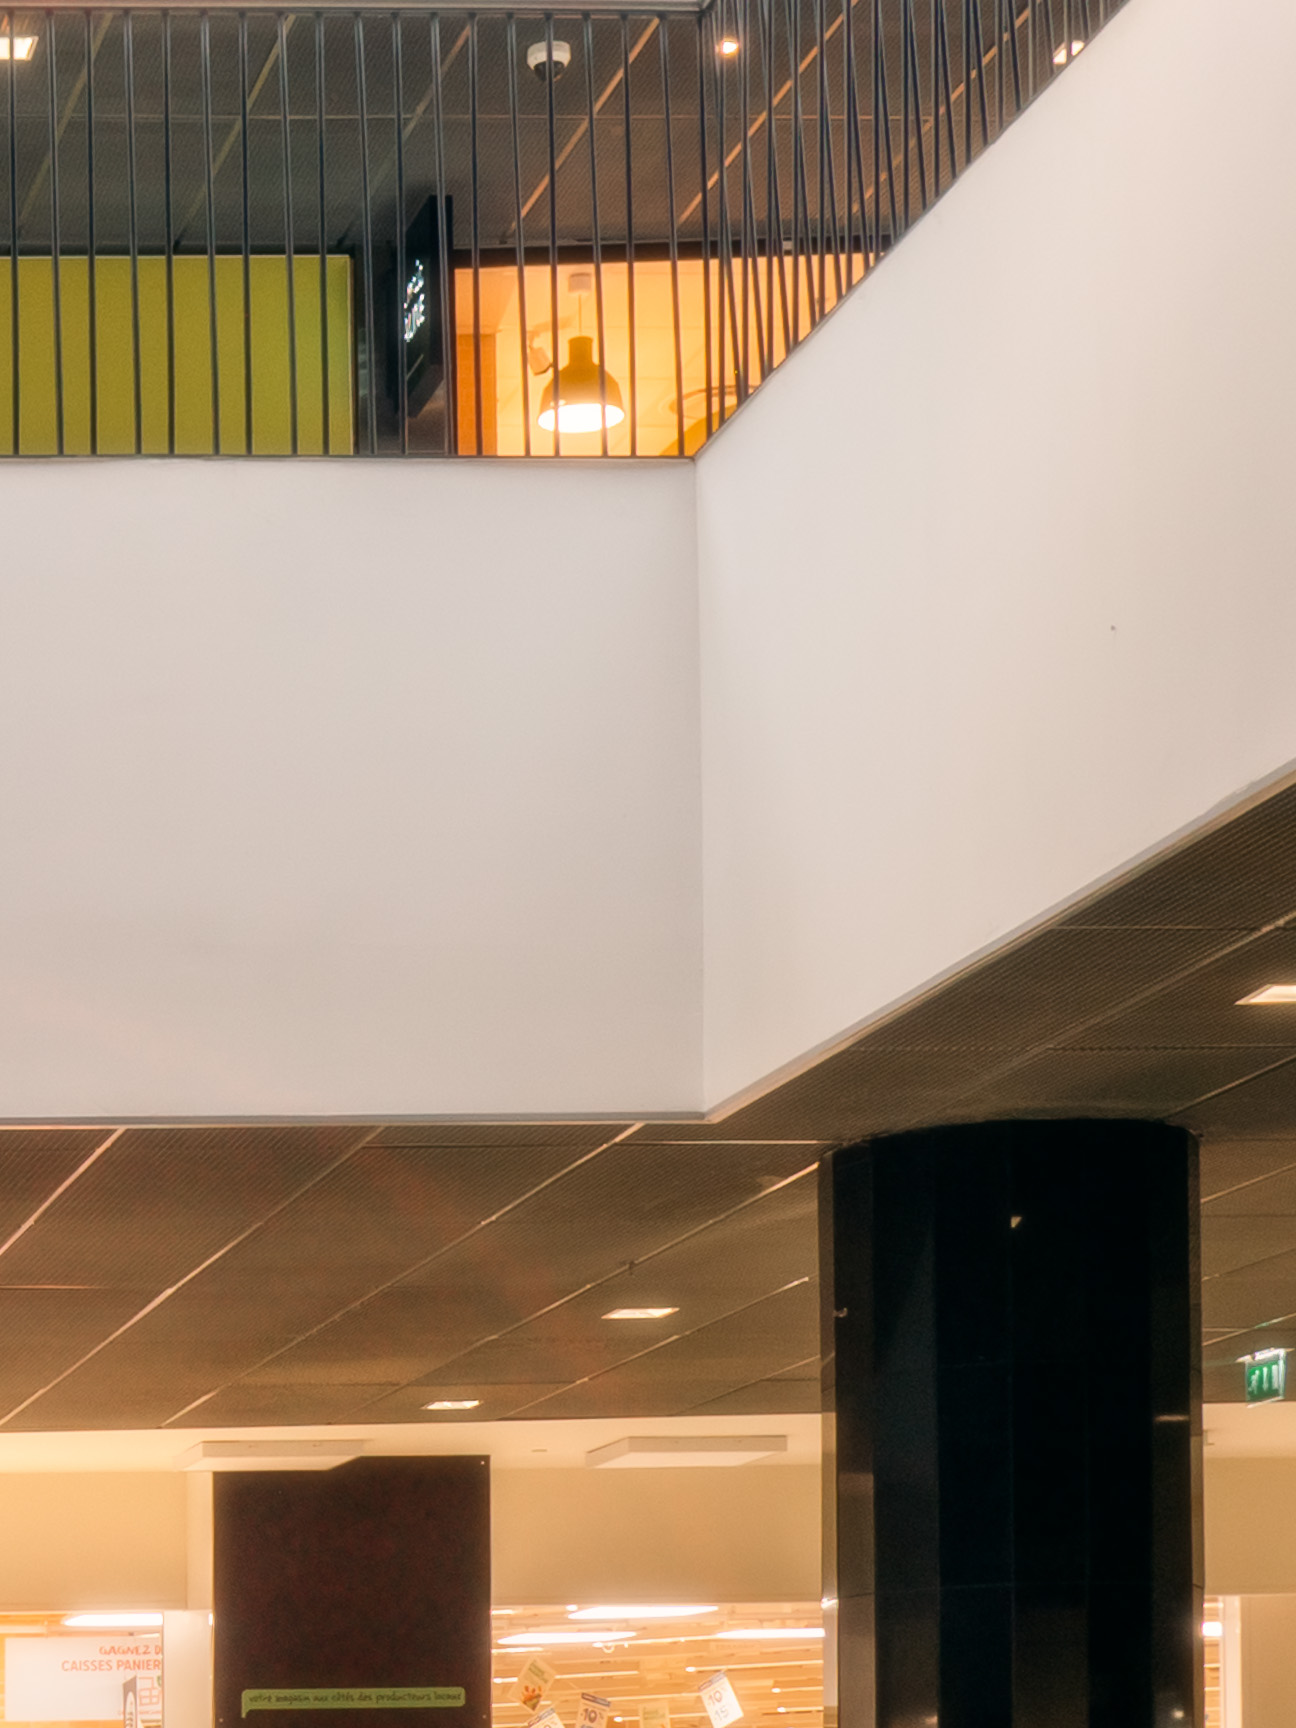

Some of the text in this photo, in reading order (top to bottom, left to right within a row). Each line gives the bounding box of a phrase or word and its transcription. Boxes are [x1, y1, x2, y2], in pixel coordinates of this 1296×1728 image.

[98, 1645, 151, 1656] GAGNEZ
[61, 1659, 161, 1672] CAISSES PANIER
